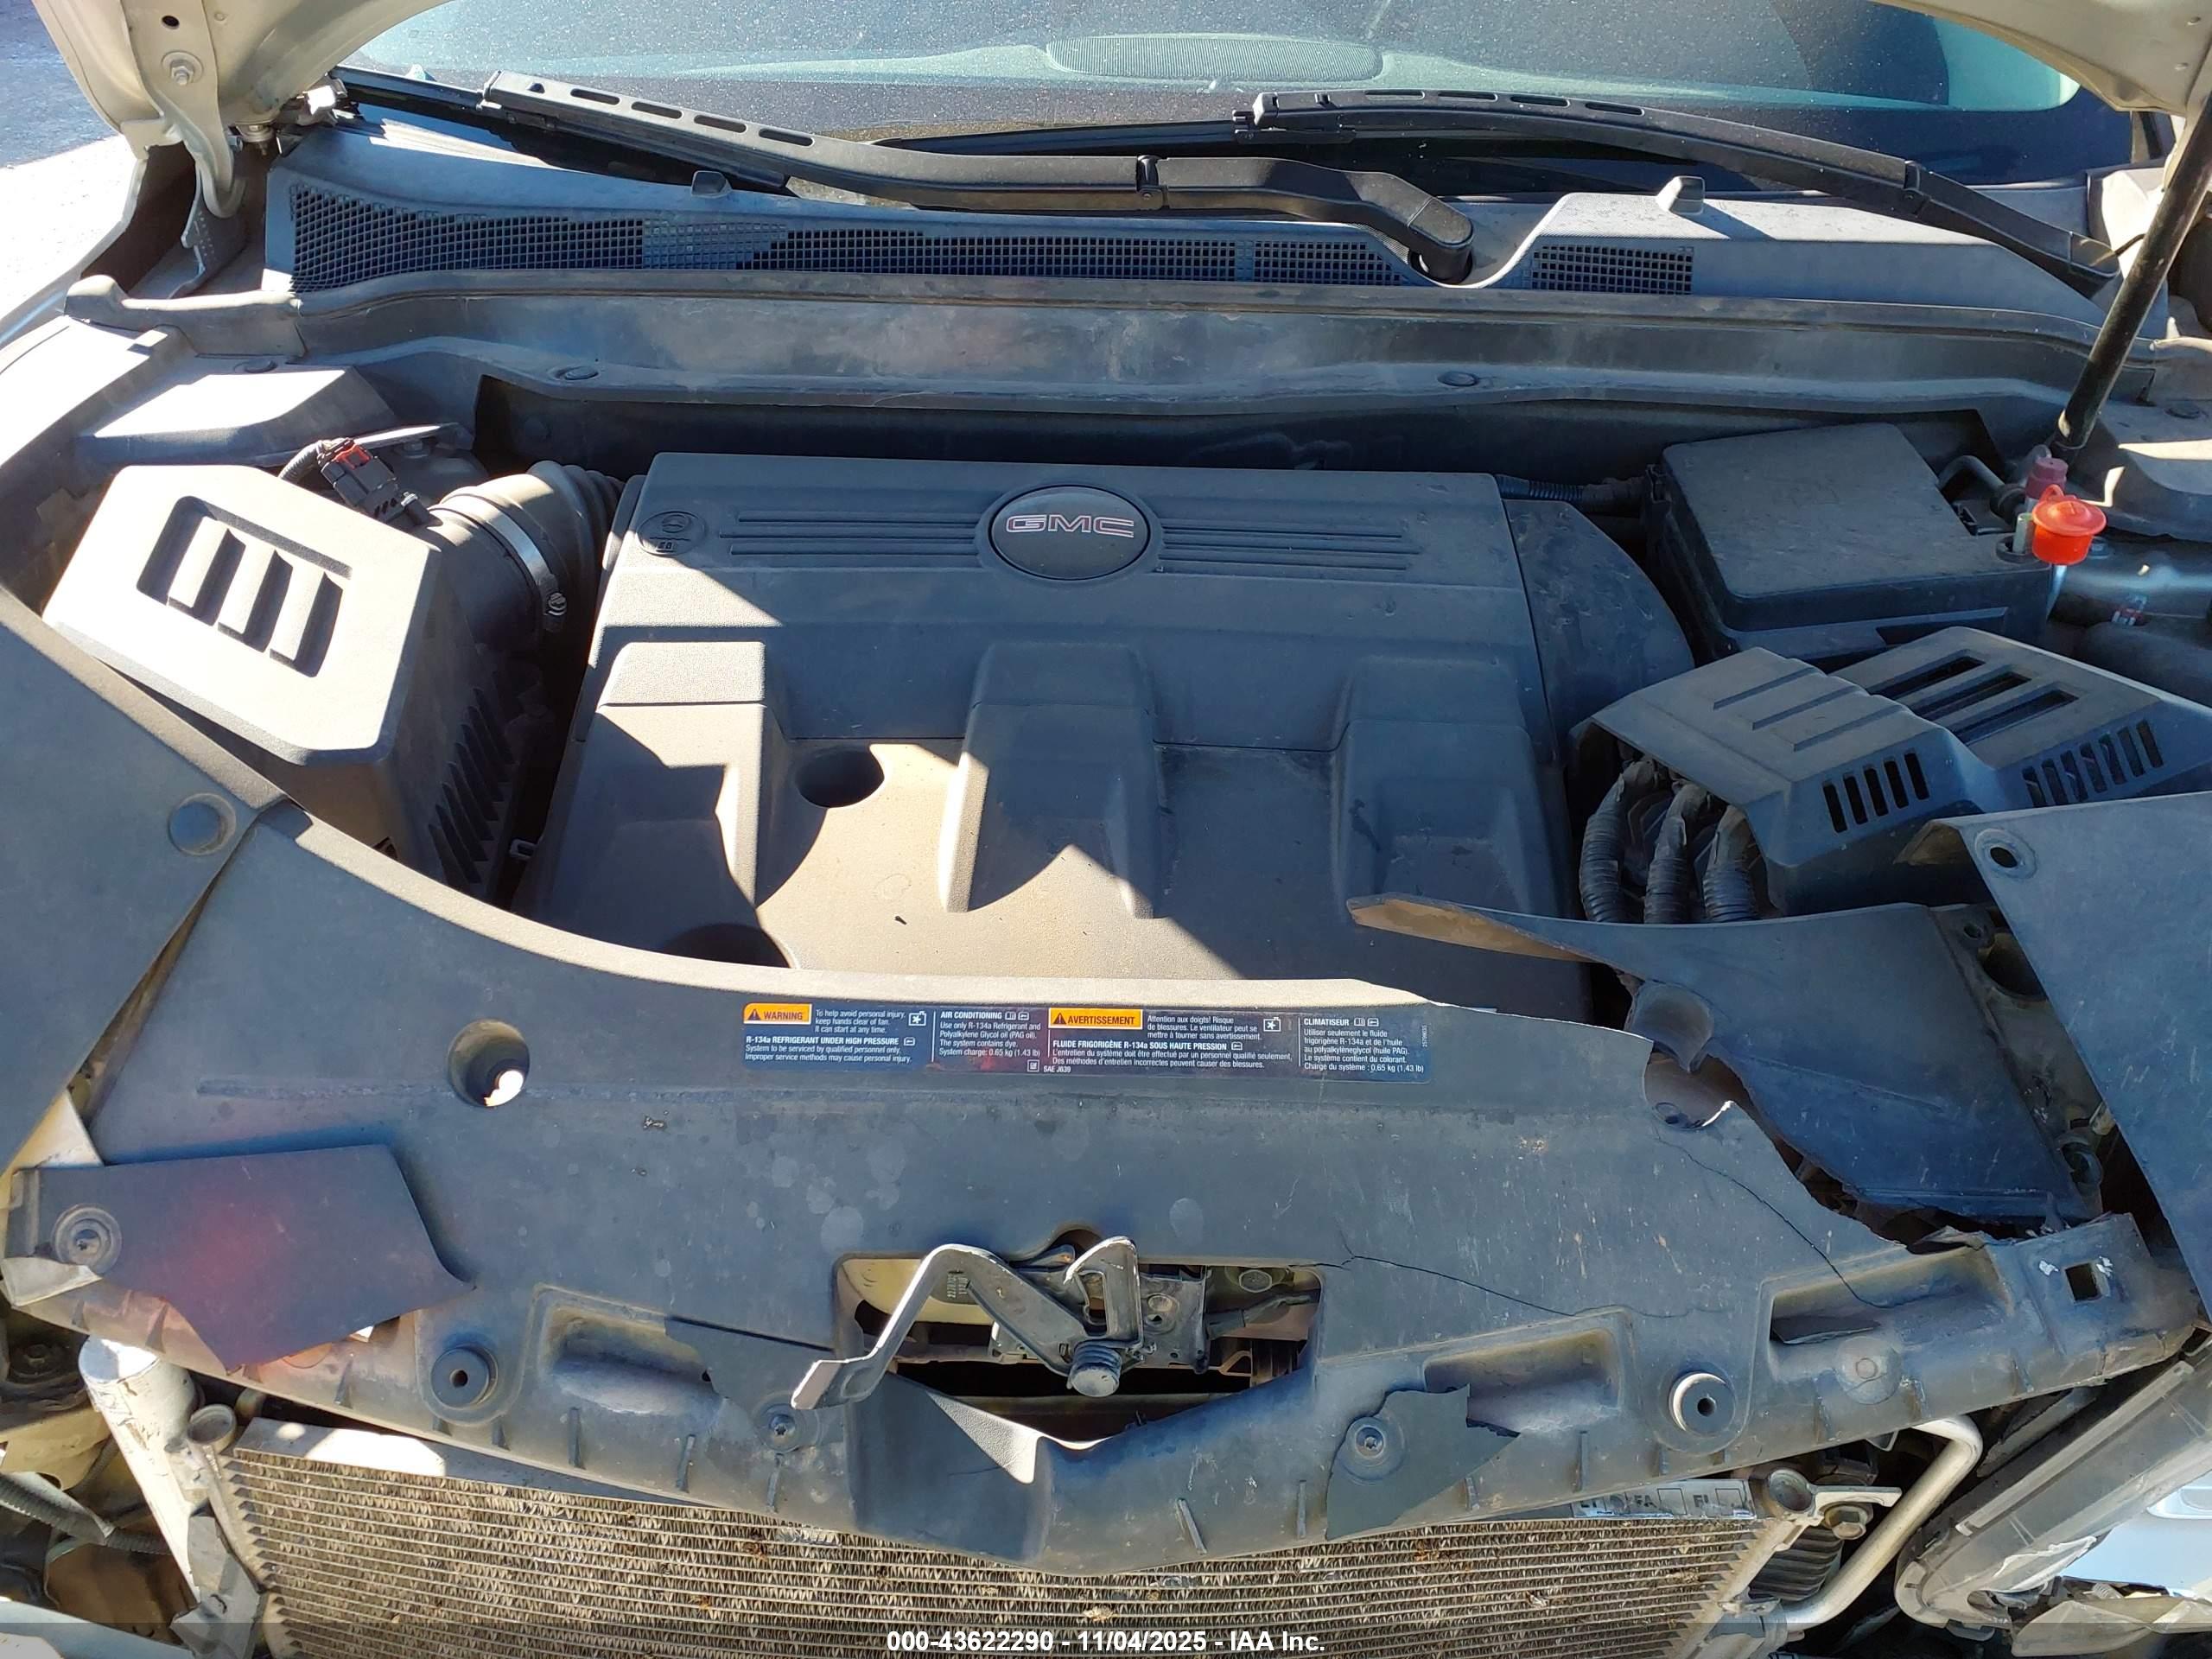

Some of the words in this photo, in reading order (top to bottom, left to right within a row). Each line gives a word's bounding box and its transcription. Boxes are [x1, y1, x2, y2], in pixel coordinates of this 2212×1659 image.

[1006, 515, 1134, 537] GMC
[825, 1009, 838, 1018] help
[1068, 1016, 1135, 1025] AVERTISSEMENT
[1234, 1025, 1248, 1033] peut
[940, 1030, 978, 1039] Polyalkylene
[1078, 1039, 1122, 1049] FRIGORIGÈNE
[1304, 1037, 1338, 1046] frigorigène
[746, 1044, 769, 1052] System
[1313, 1046, 1371, 1055] polyalkylèneglycol
[964, 1049, 988, 1058] charge:
[1096, 1050, 1122, 1058] système
[1313, 1054, 1339, 1063] système
[1305, 1063, 1326, 1071] Charge
[1338, 1063, 1365, 1072] système
[1387, 1065, 1395, 1073] kg
